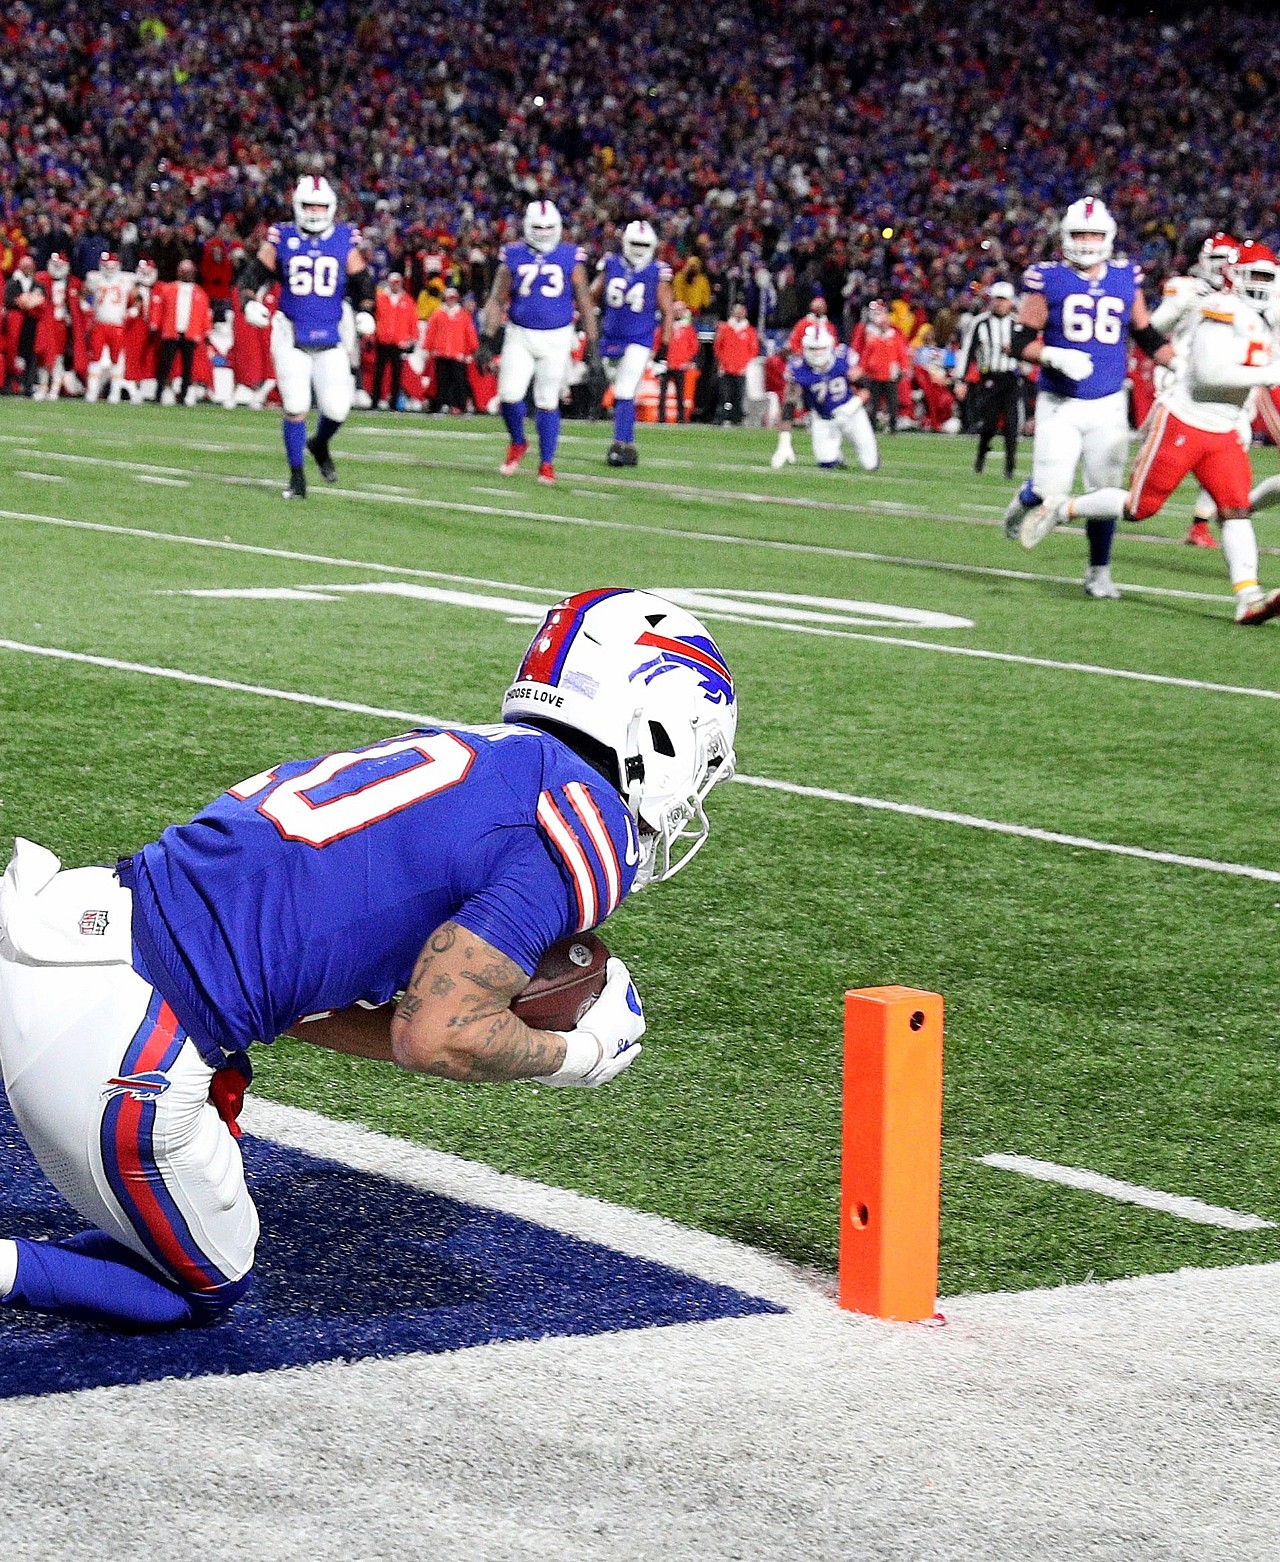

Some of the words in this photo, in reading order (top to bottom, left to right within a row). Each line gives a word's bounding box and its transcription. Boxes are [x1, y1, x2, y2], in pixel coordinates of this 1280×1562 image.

[289, 255, 339, 296] 60
[517, 263, 565, 298] 73
[606, 277, 645, 313] 64
[1062, 293, 1125, 345] 66
[810, 376, 848, 403] 79
[534, 689, 565, 708] LOVE
[226, 731, 477, 849] 0
